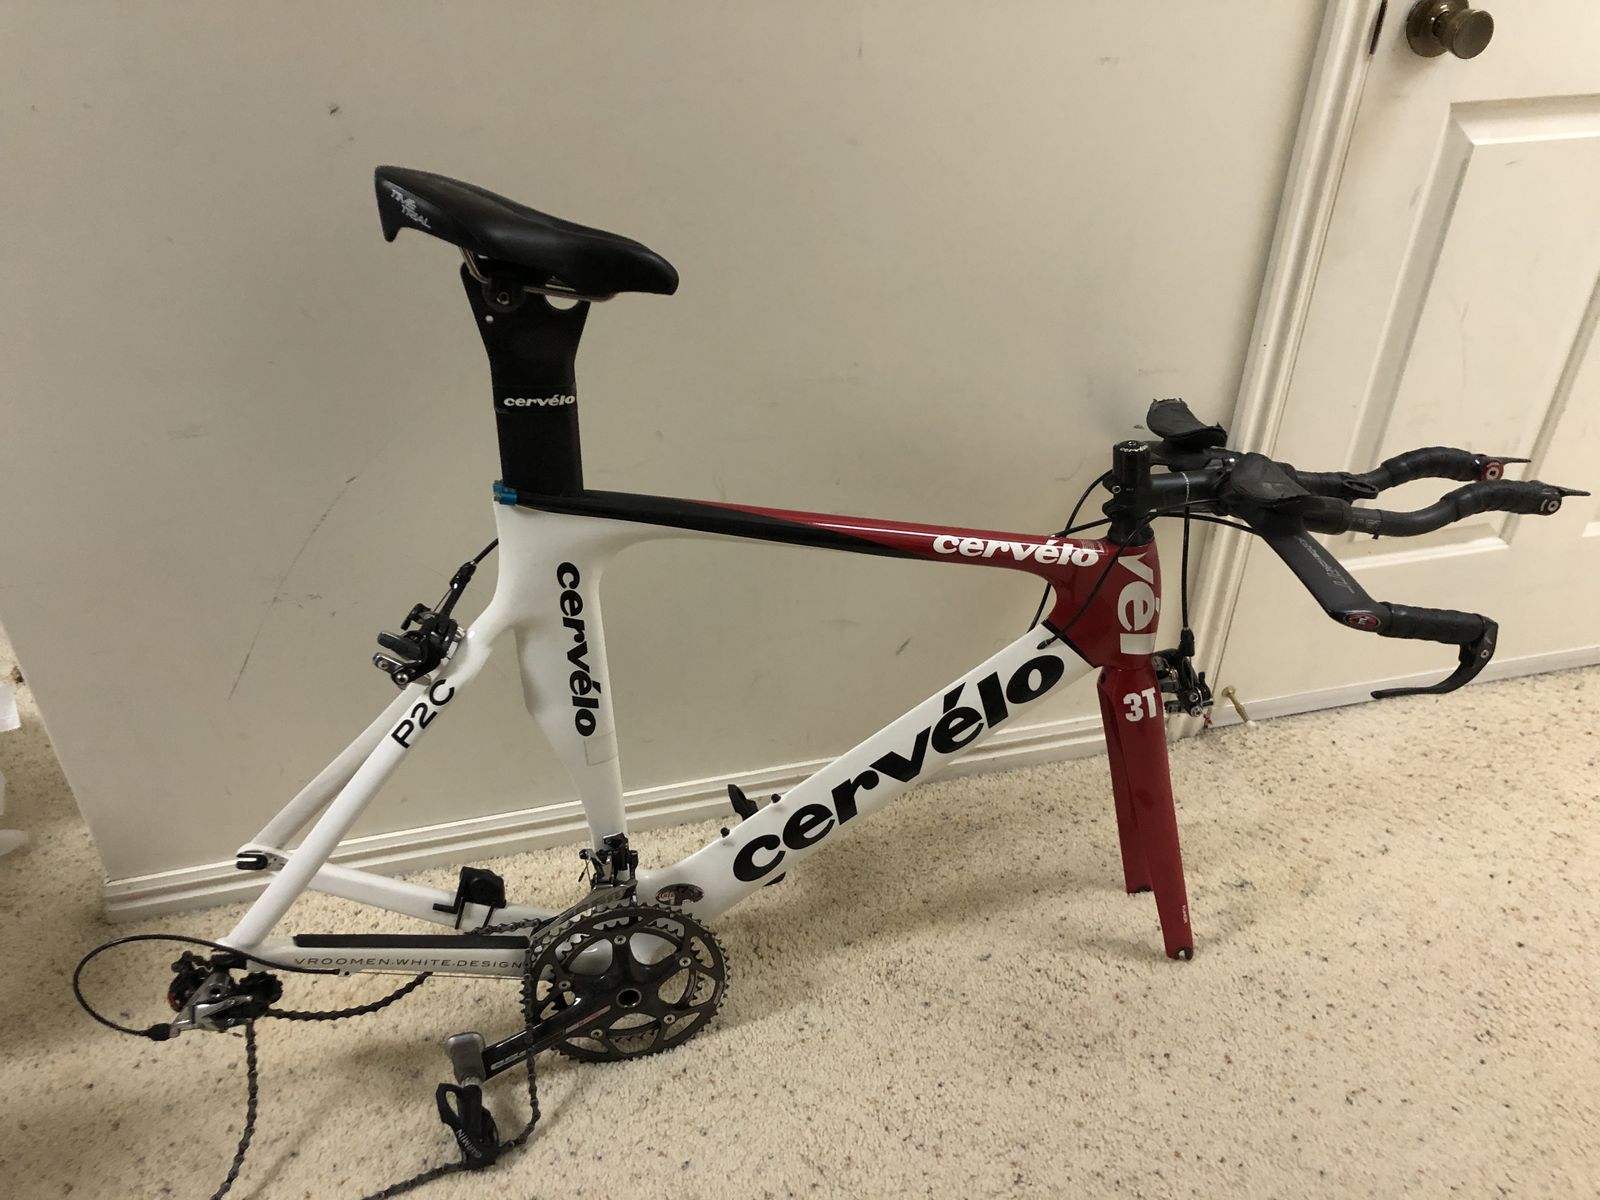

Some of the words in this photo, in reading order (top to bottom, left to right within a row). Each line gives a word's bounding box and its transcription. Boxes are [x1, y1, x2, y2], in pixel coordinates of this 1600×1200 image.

[504, 394, 575, 407] cervélo
[933, 535, 1099, 567] cervélo
[556, 562, 601, 737] cervélo
[391, 679, 455, 749] P2C
[1123, 687, 1157, 722] 3T
[733, 655, 1065, 882] cervélo
